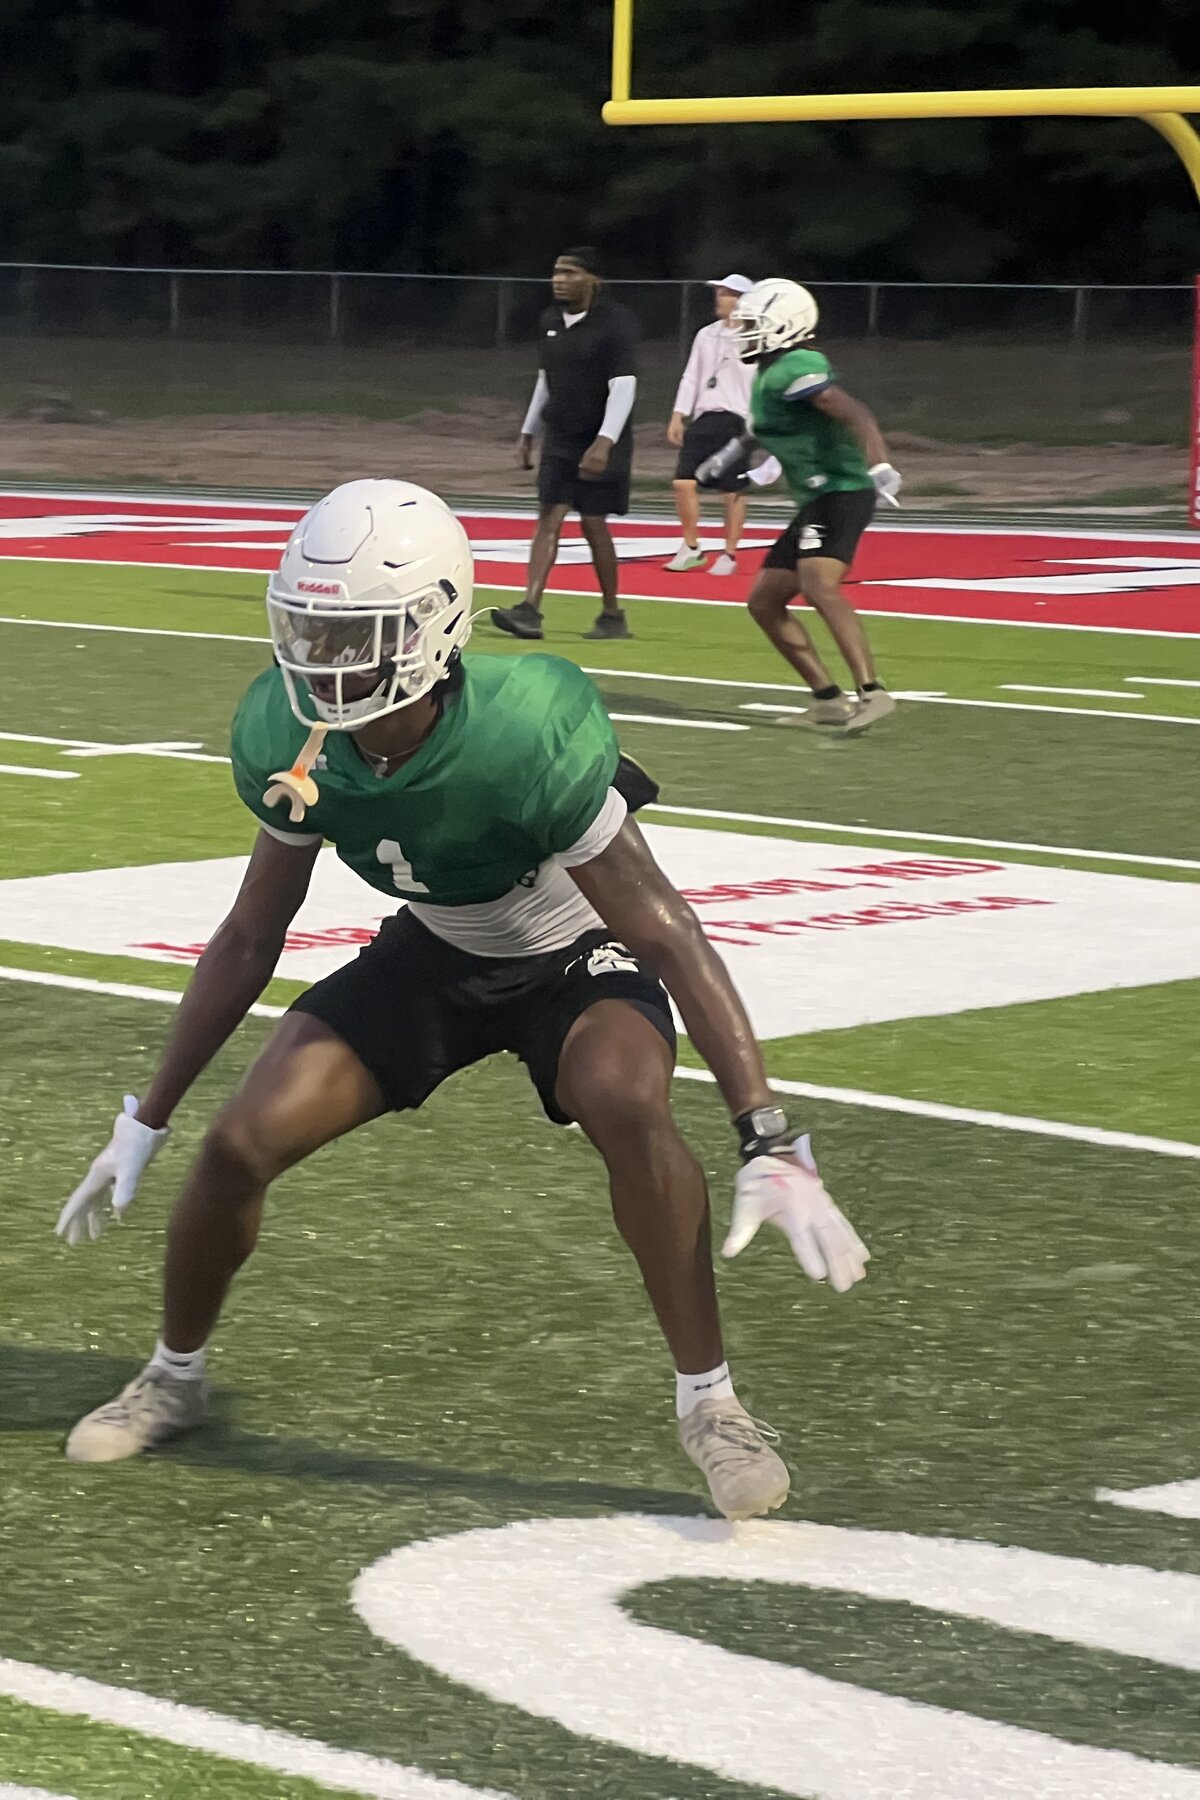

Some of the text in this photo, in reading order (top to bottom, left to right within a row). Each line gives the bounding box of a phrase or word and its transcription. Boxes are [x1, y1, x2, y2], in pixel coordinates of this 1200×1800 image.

[297, 581, 341, 595] Riddell
[376, 838, 431, 894] 1
[814, 858, 1007, 881] MD
[701, 895, 1057, 936] Practice
